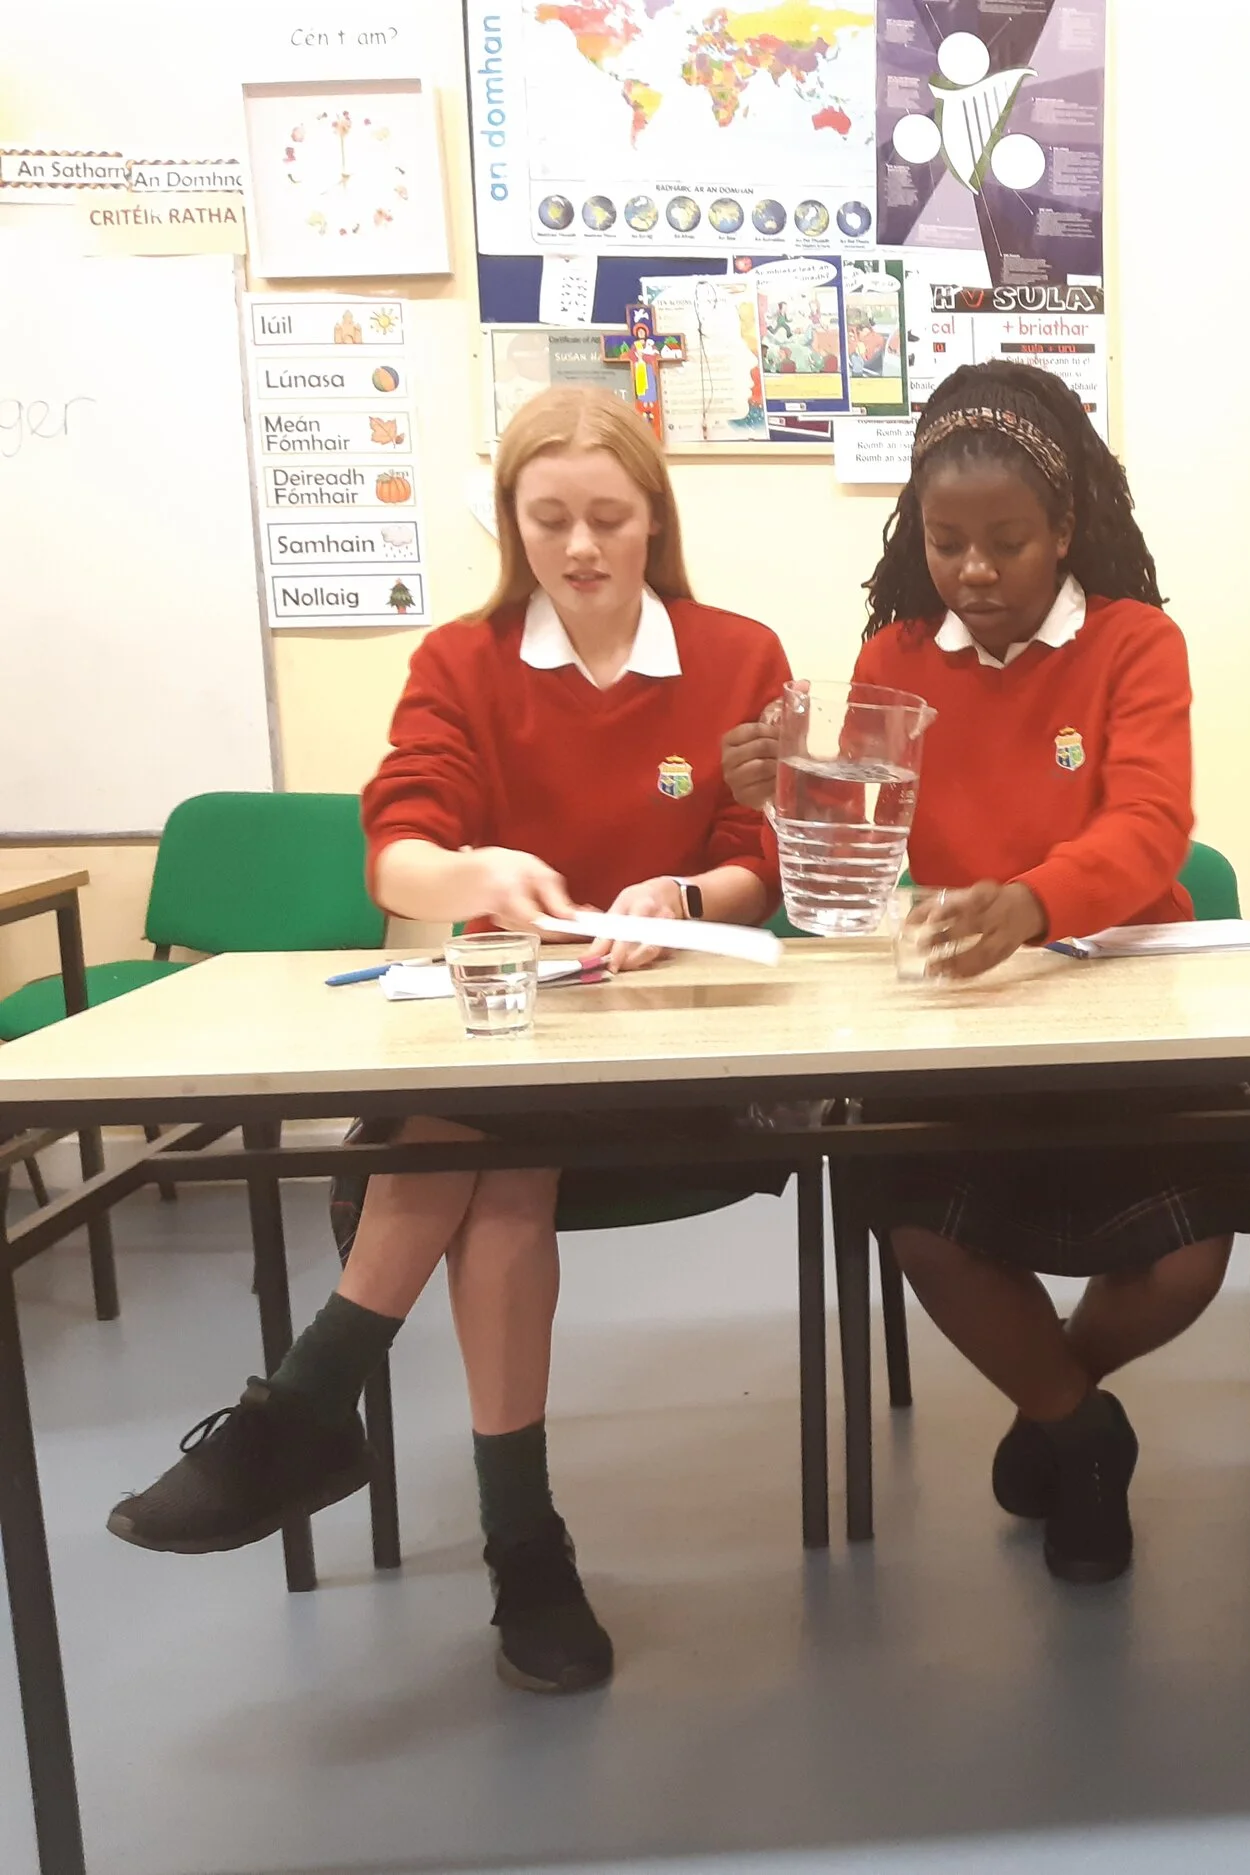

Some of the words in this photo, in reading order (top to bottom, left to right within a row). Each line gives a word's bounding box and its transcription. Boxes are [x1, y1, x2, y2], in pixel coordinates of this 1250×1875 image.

[477, 15, 506, 147] domhan
[17, 160, 45, 177] An
[134, 172, 160, 187] An
[490, 162, 509, 201] an
[169, 207, 238, 225] RATHA
[992, 286, 1096, 312] SULA
[1018, 316, 1090, 336] briathar
[265, 368, 346, 390] Lúnasa
[264, 414, 321, 433] Meán
[266, 434, 350, 452] Fómhair
[272, 468, 365, 487] Deireadh
[274, 487, 359, 506] Fómhair
[277, 534, 376, 555] Samhain
[281, 586, 360, 609] Nollaig
